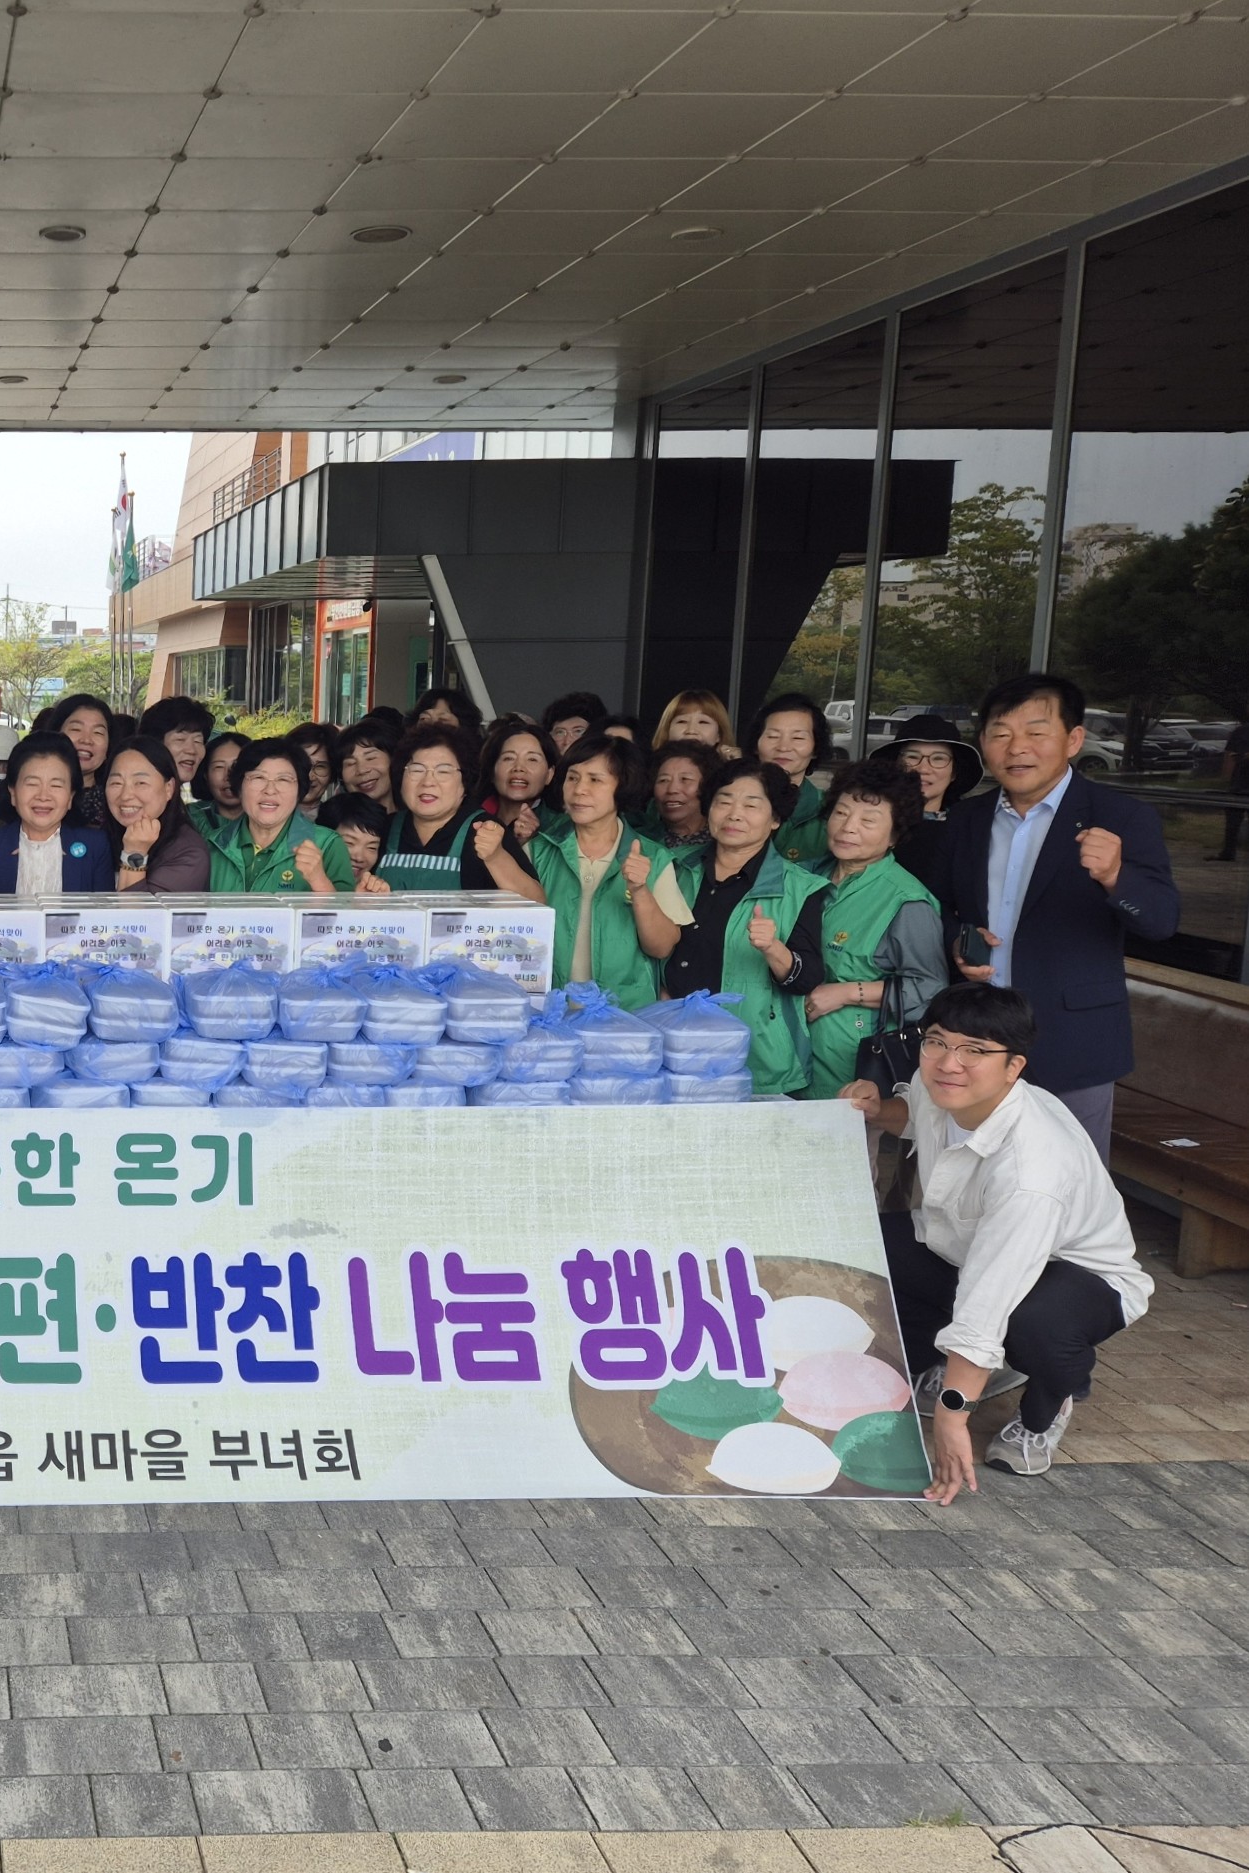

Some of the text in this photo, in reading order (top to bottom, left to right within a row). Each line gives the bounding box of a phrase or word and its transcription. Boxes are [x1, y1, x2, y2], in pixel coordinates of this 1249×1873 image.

[61, 926, 85, 934] 따뜻한
[188, 926, 212, 934] 따뜻한
[218, 926, 233, 934] 온기
[318, 926, 342, 934] 따뜻한
[348, 926, 364, 934] 온기
[447, 925, 472, 933] 따뜻한
[368, 940, 384, 948] 이웃
[115, 1132, 253, 1206] 온기
[348, 1250, 542, 1383] 나눔
[561, 1246, 766, 1382] 행사
[37, 1429, 189, 1483] 새마을
[209, 1428, 362, 1482] 부녀회
